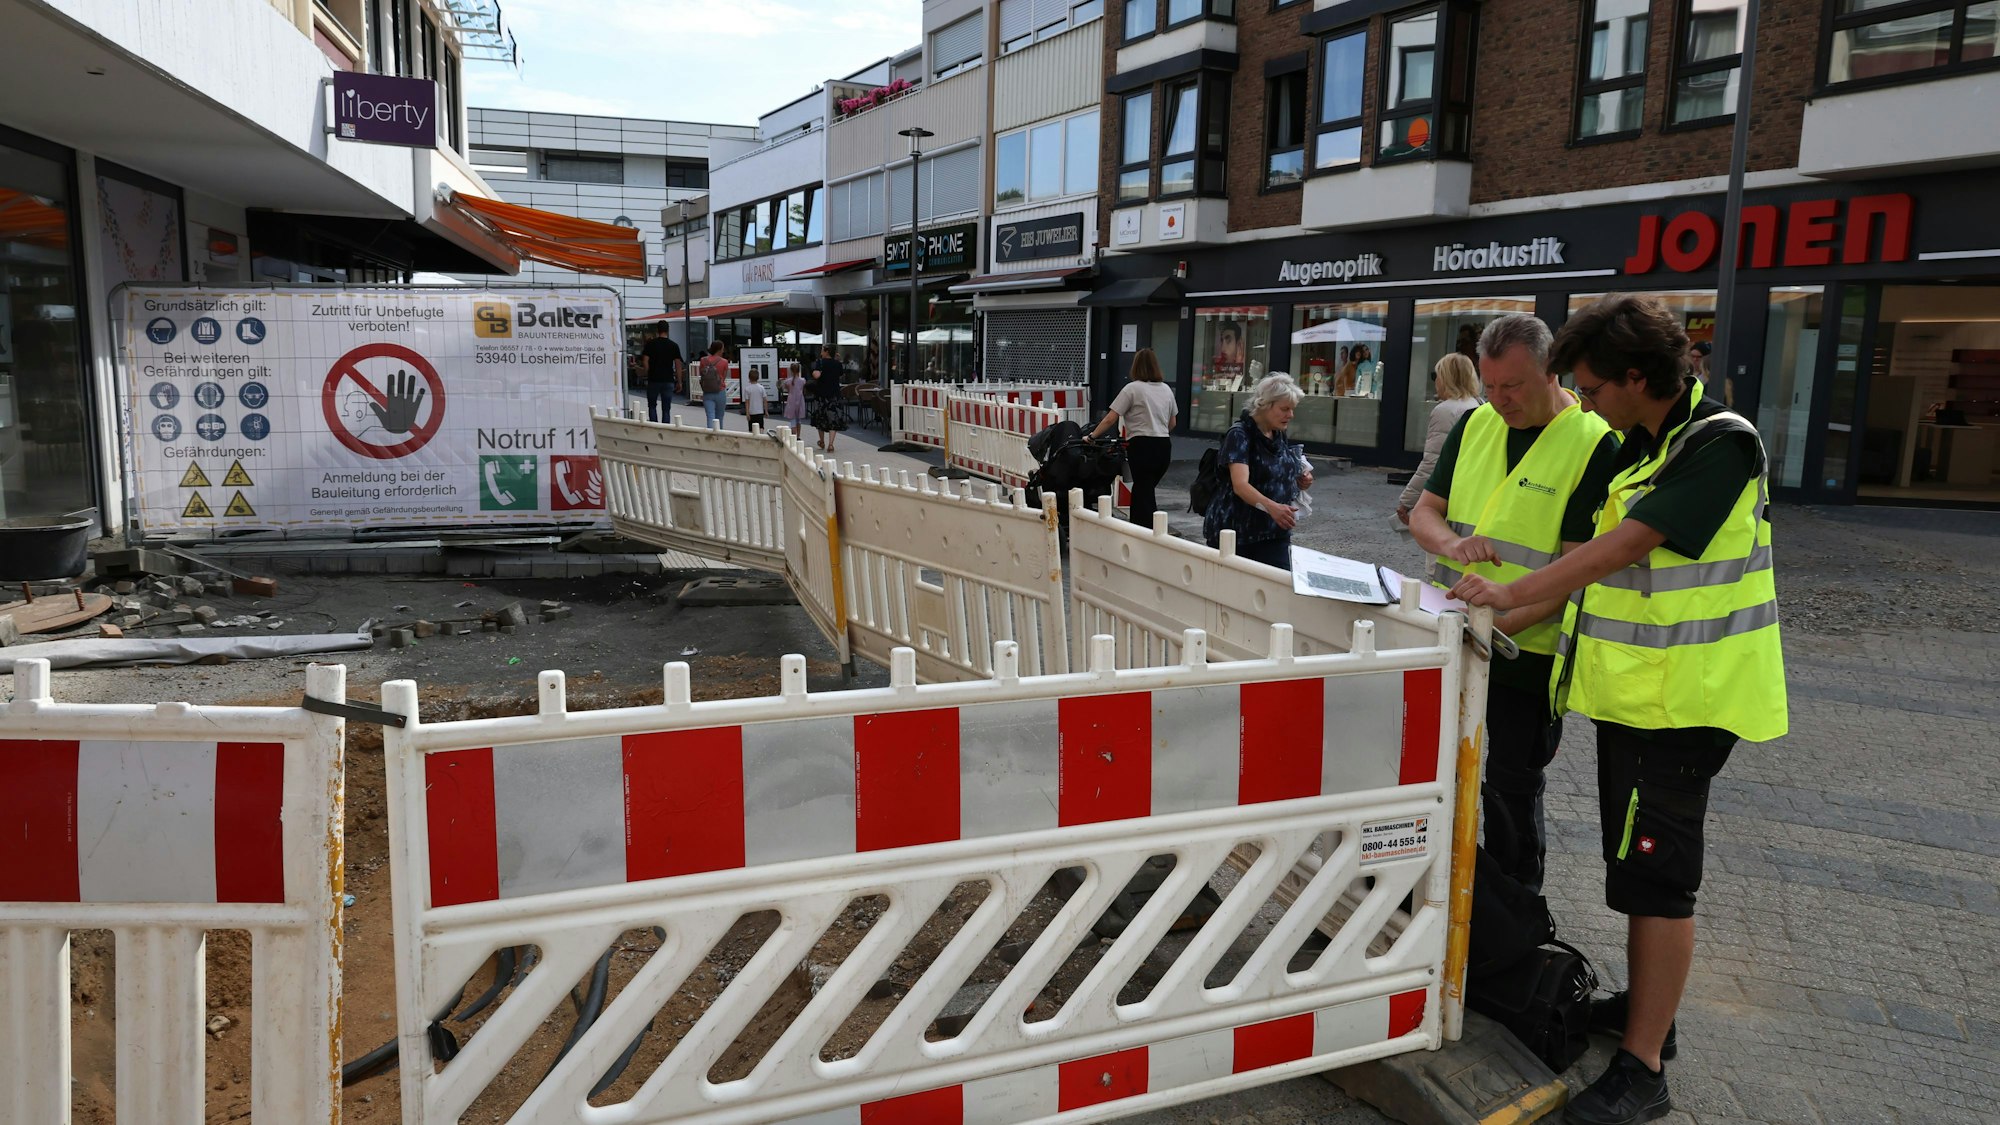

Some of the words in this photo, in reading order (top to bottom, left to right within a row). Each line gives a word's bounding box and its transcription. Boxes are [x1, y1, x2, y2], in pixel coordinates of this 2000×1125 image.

[341, 89, 428, 130] liberty
[1035, 225, 1078, 246] JUWELIER
[1624, 193, 1914, 275] JONEN
[928, 232, 964, 256] PHONE
[1433, 237, 1566, 272] Hörakustik
[1278, 253, 1383, 286] Augenoptik
[144, 299, 238, 312] Grundsätzlich
[243, 300, 266, 314] gilt:
[312, 304, 351, 316] Zutritt
[355, 304, 372, 316] für
[376, 306, 444, 320] Unbefugte
[517, 303, 603, 329] Balter
[348, 321, 410, 332] verboten!
[518, 331, 605, 340] BAUUNTERNEHMUNG
[164, 352, 186, 364] Bei
[191, 353, 250, 364] weiteren
[476, 353, 516, 364] 53940
[521, 353, 606, 365] Losheim/Eifel
[143, 365, 243, 380] Gefährdungen
[248, 366, 272, 380] gilt:
[478, 428, 556, 449] Notruf
[566, 428, 597, 449] 11
[163, 446, 266, 459] Gefährdungen:
[322, 471, 396, 484] Anmeldung
[401, 470, 420, 481] bei
[424, 470, 445, 481] der
[312, 487, 380, 499] Bauleitung
[384, 485, 457, 496] erforderlich
[310, 508, 343, 516] Generell
[344, 507, 370, 517] gemäß
[372, 505, 463, 514] Gefährdungsbeurteilung
[1375, 822, 1414, 832] BAUMASCHINEN
[1400, 837, 1415, 847] 555
[1416, 835, 1427, 844] 44
[1361, 846, 1426, 860] hkl-baumaschinen.de
